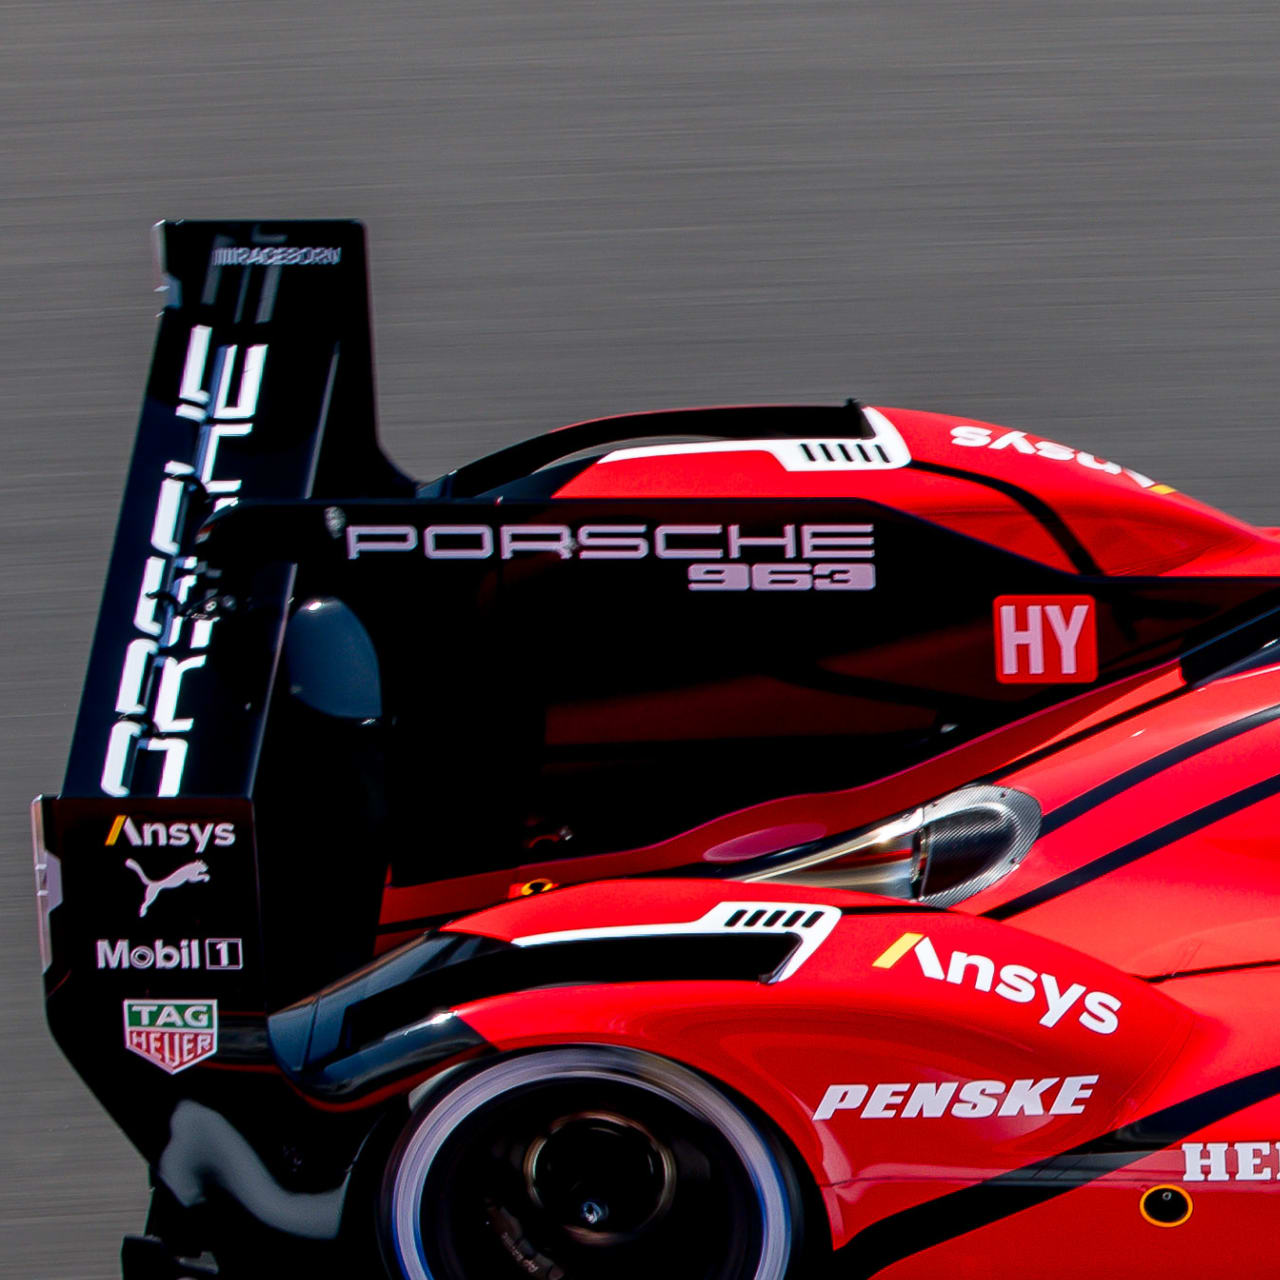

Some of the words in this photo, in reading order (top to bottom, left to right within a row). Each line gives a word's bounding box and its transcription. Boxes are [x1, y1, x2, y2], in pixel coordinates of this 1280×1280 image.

[950, 426, 1177, 495] Ansys
[346, 523, 876, 560] PORSCHE
[687, 563, 876, 592] 963
[1000, 605, 1089, 675] HY
[105, 815, 236, 853] Ansys
[96, 939, 201, 969] Mobil
[872, 932, 1123, 1035] Ansys
[131, 1005, 209, 1028] TAG
[130, 1031, 212, 1068] HEUER
[812, 1073, 1100, 1121] PENSKE
